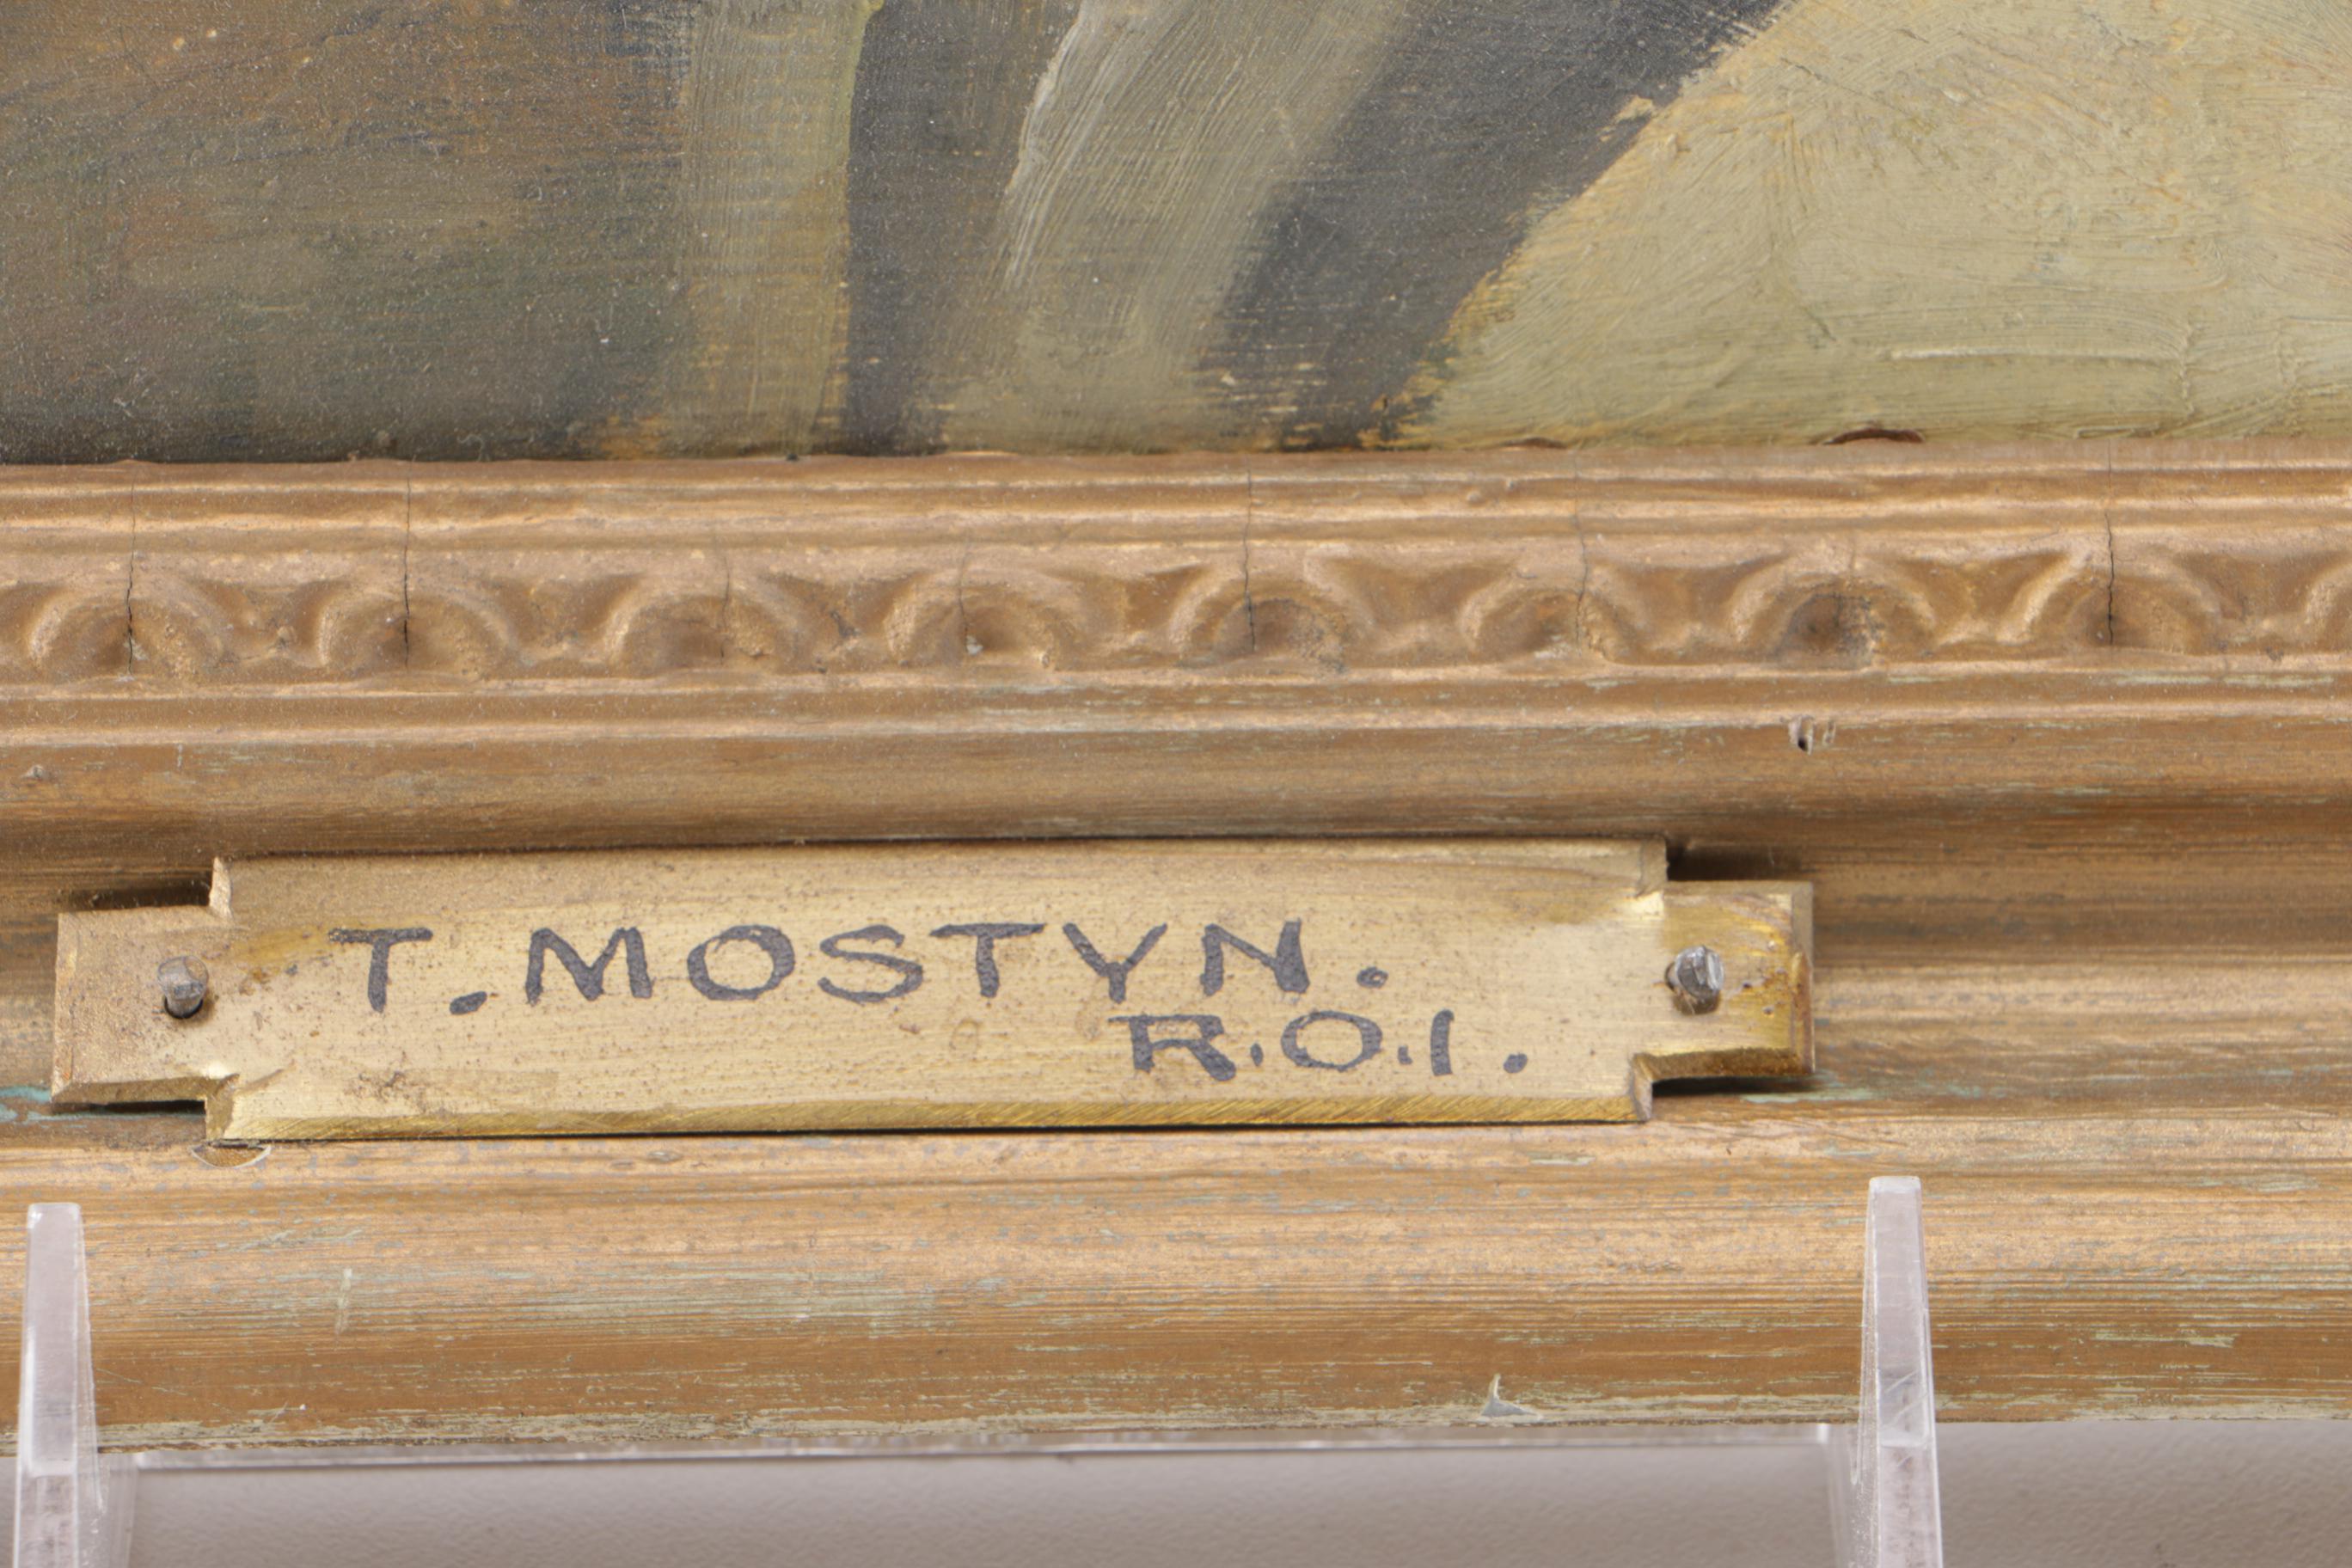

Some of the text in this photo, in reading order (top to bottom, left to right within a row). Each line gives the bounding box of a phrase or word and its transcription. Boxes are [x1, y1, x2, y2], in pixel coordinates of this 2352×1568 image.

[327, 917, 1390, 1015] T. MOSTYN.
[1108, 1008, 1528, 1081] R.O.I.
